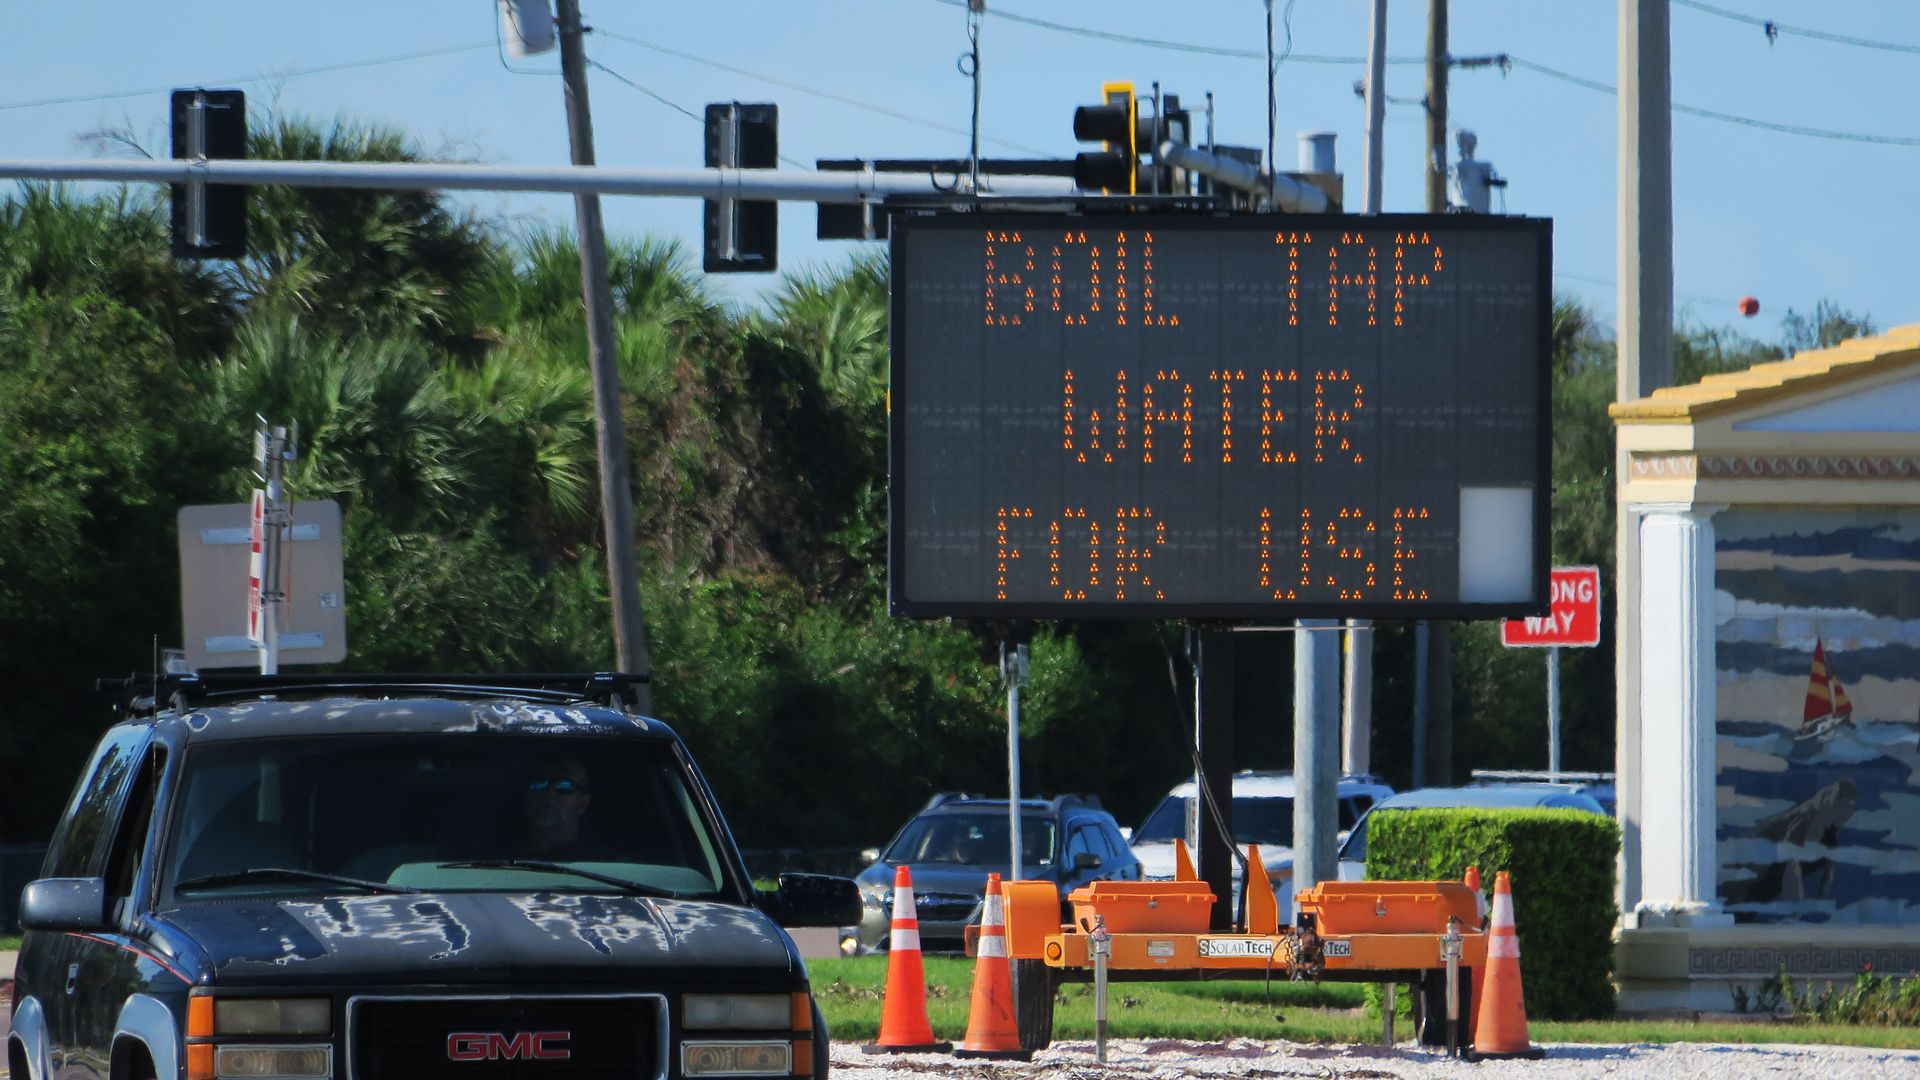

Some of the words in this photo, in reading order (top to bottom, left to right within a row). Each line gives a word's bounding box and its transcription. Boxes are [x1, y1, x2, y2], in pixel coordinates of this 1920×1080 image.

[985, 231, 1179, 326] BOIL
[1275, 231, 1443, 326] TAP
[1063, 369, 1364, 464] WATER
[997, 507, 1165, 600] FOR
[1260, 507, 1429, 600] USE
[1524, 611, 1576, 636] WAY
[447, 1031, 571, 1061] GMC
